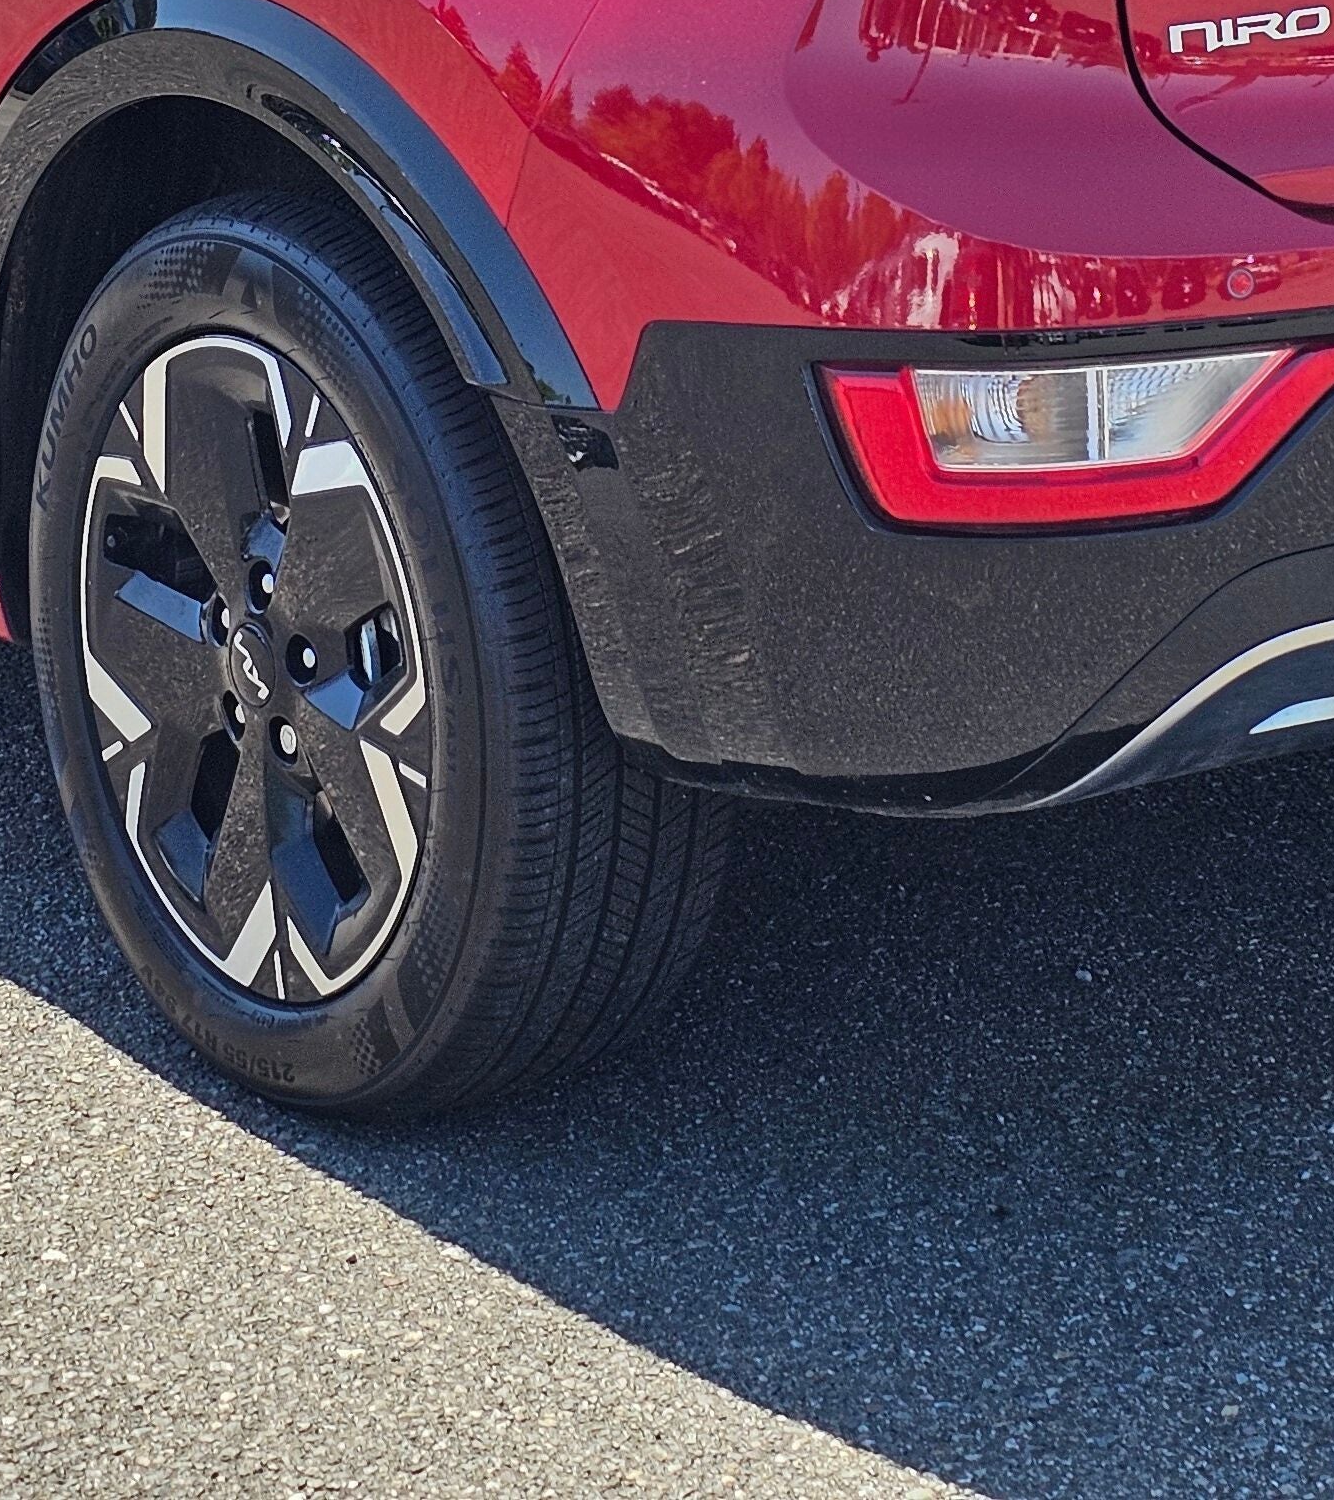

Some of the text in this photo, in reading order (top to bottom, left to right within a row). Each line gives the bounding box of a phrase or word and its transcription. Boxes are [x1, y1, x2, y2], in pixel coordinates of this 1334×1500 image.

[1169, 5, 1331, 53] NIRO
[35, 323, 97, 512] KUMHO
[222, 1042, 297, 1084] 215/55
